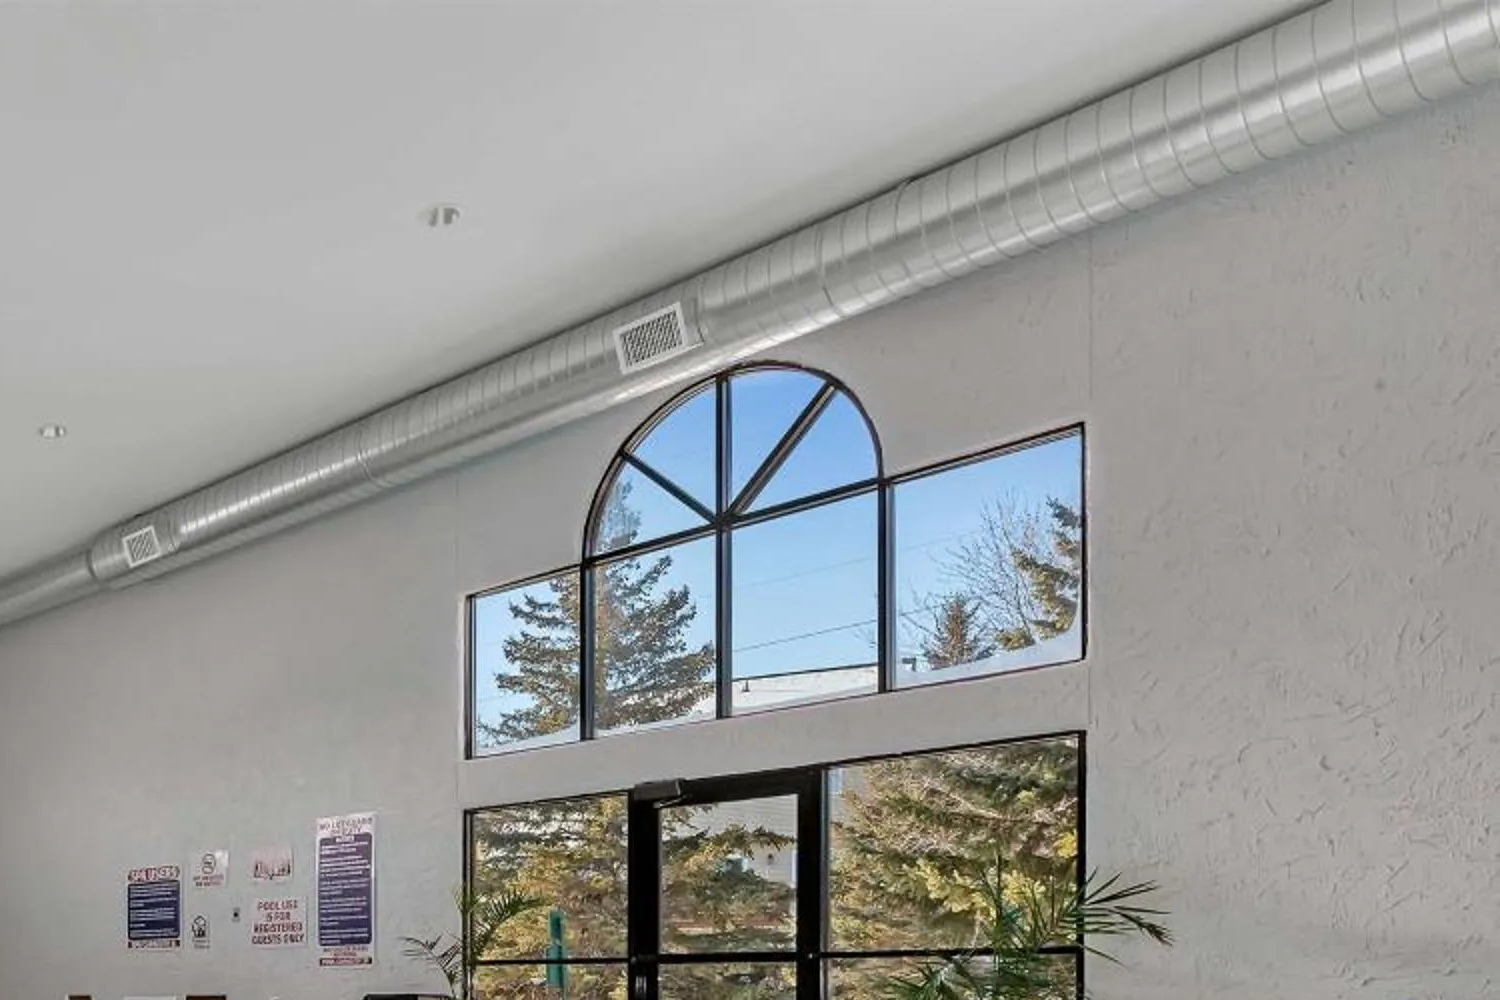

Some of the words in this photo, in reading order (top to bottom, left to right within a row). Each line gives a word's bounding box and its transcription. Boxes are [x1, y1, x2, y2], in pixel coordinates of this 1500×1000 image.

[257, 901, 281, 911] POOL
[253, 921, 303, 932] REGISTERED
[252, 934, 281, 945] GUESTS
[283, 933, 305, 943] ONLY
